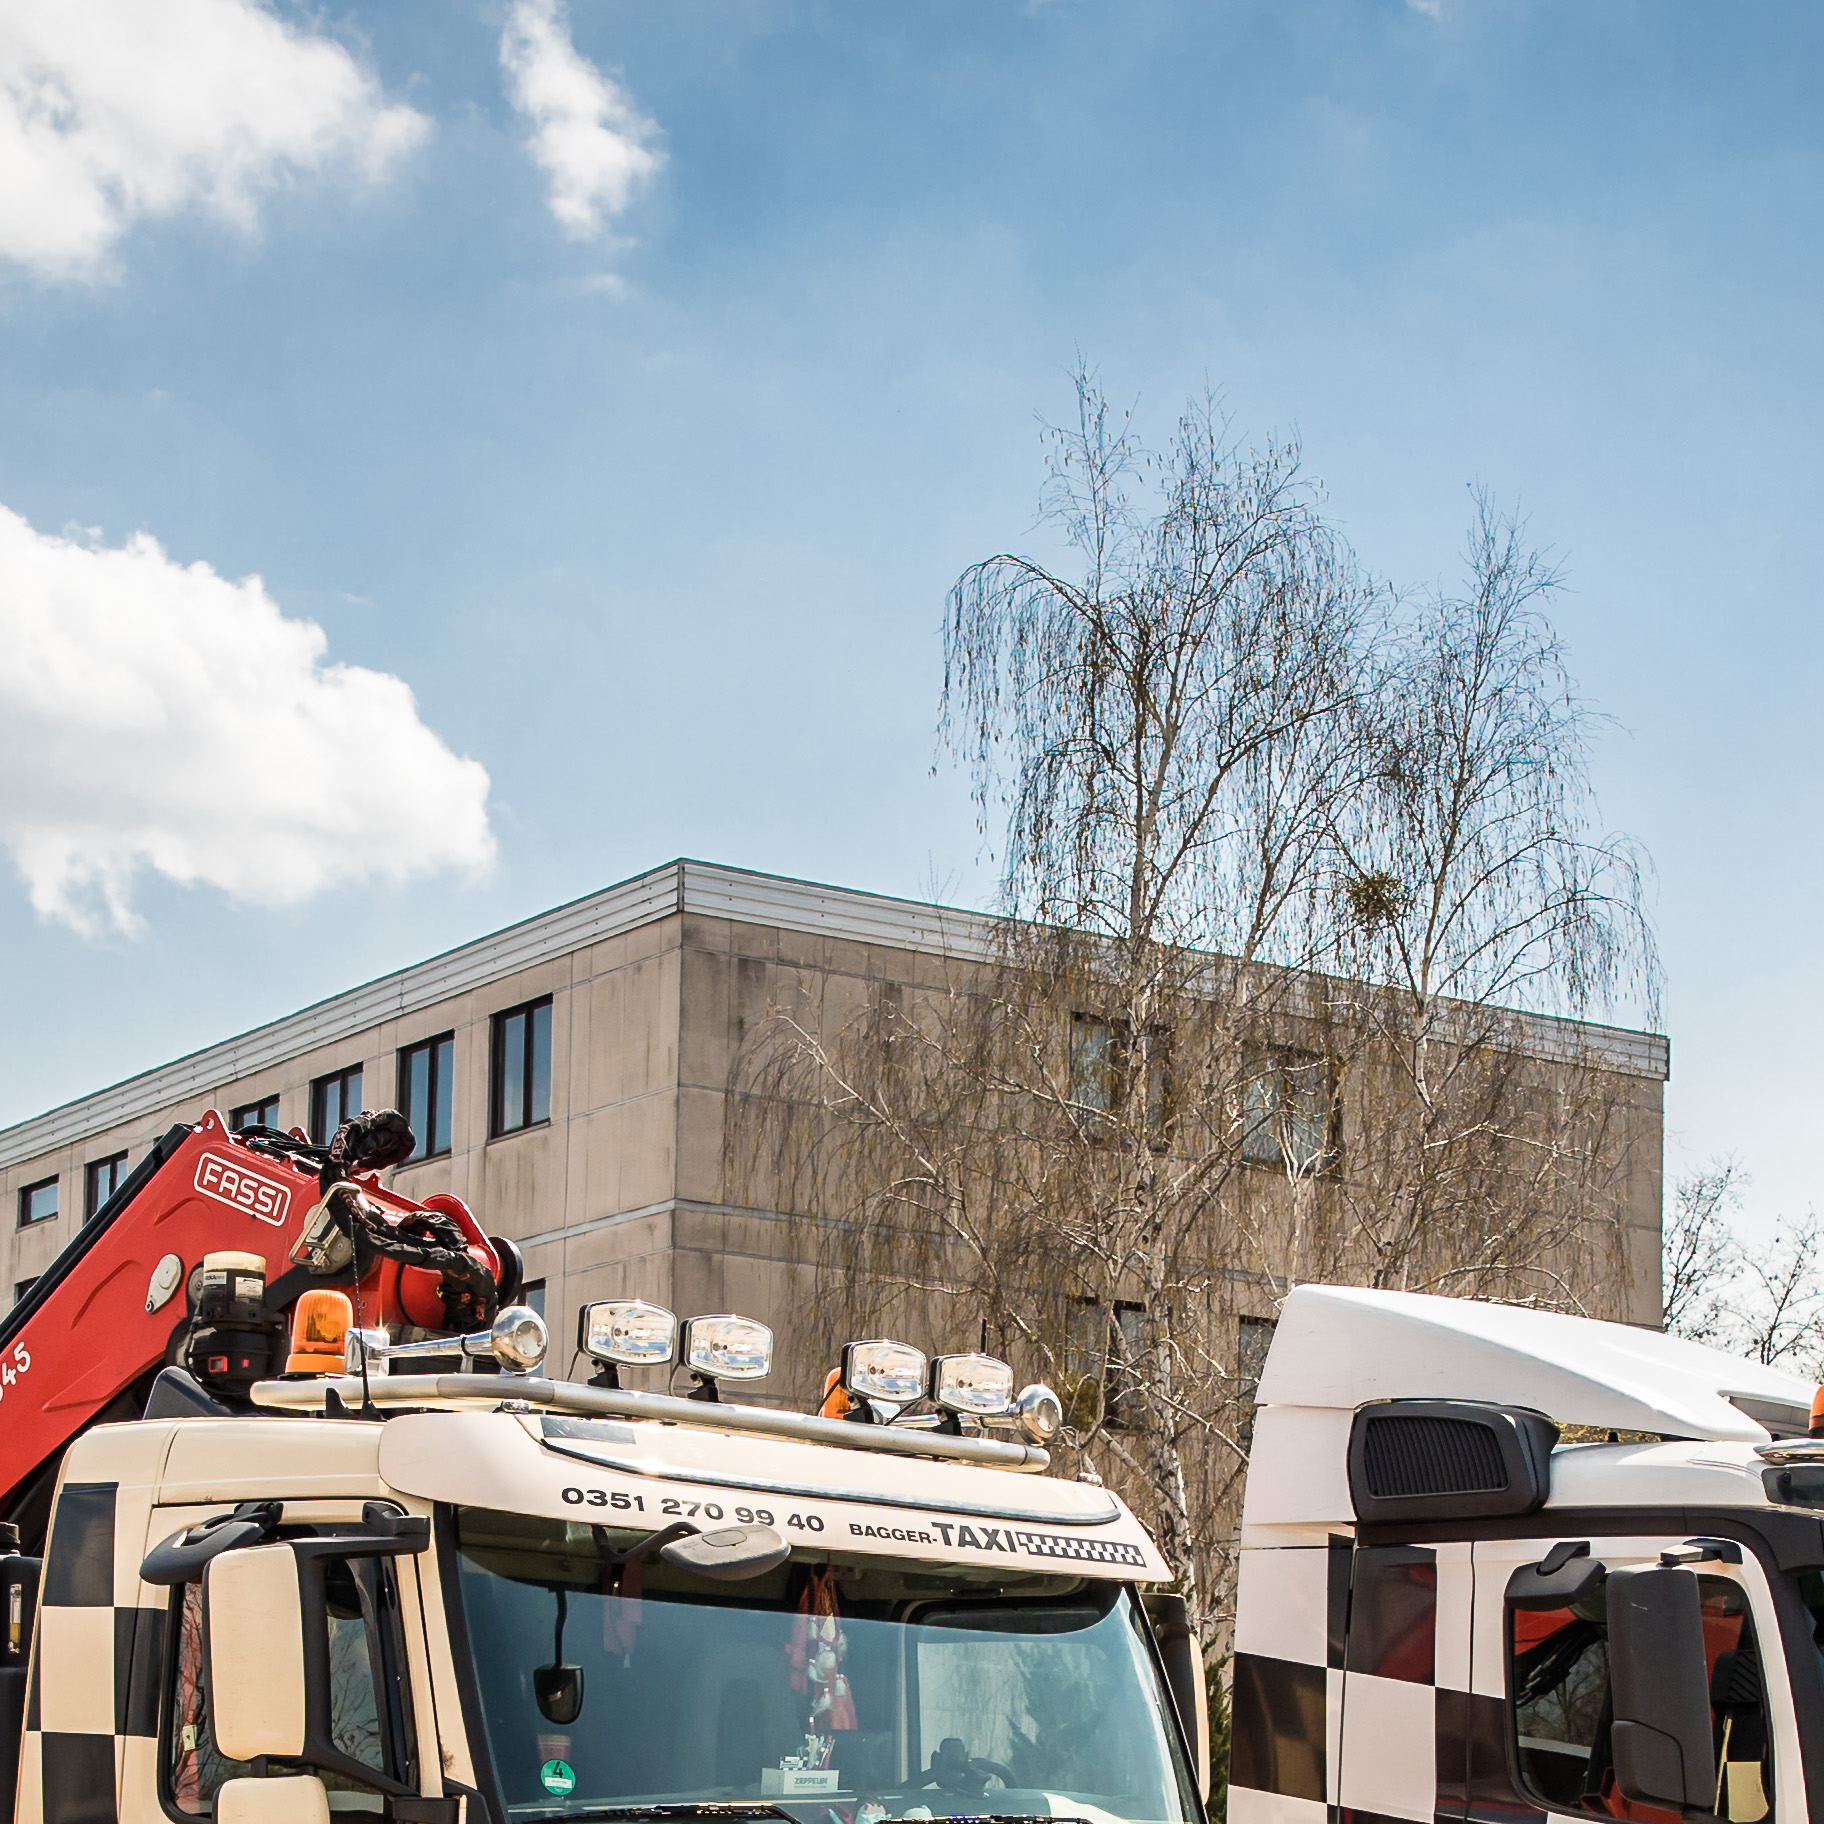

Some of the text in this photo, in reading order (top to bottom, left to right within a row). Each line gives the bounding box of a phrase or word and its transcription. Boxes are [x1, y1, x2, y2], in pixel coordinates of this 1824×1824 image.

[202, 1161, 283, 1217] FASSI
[561, 1487, 825, 1532] 0351 270 99 40
[849, 1521, 1018, 1553] BAGGER-TAXI
[553, 1760, 564, 1778] 4
